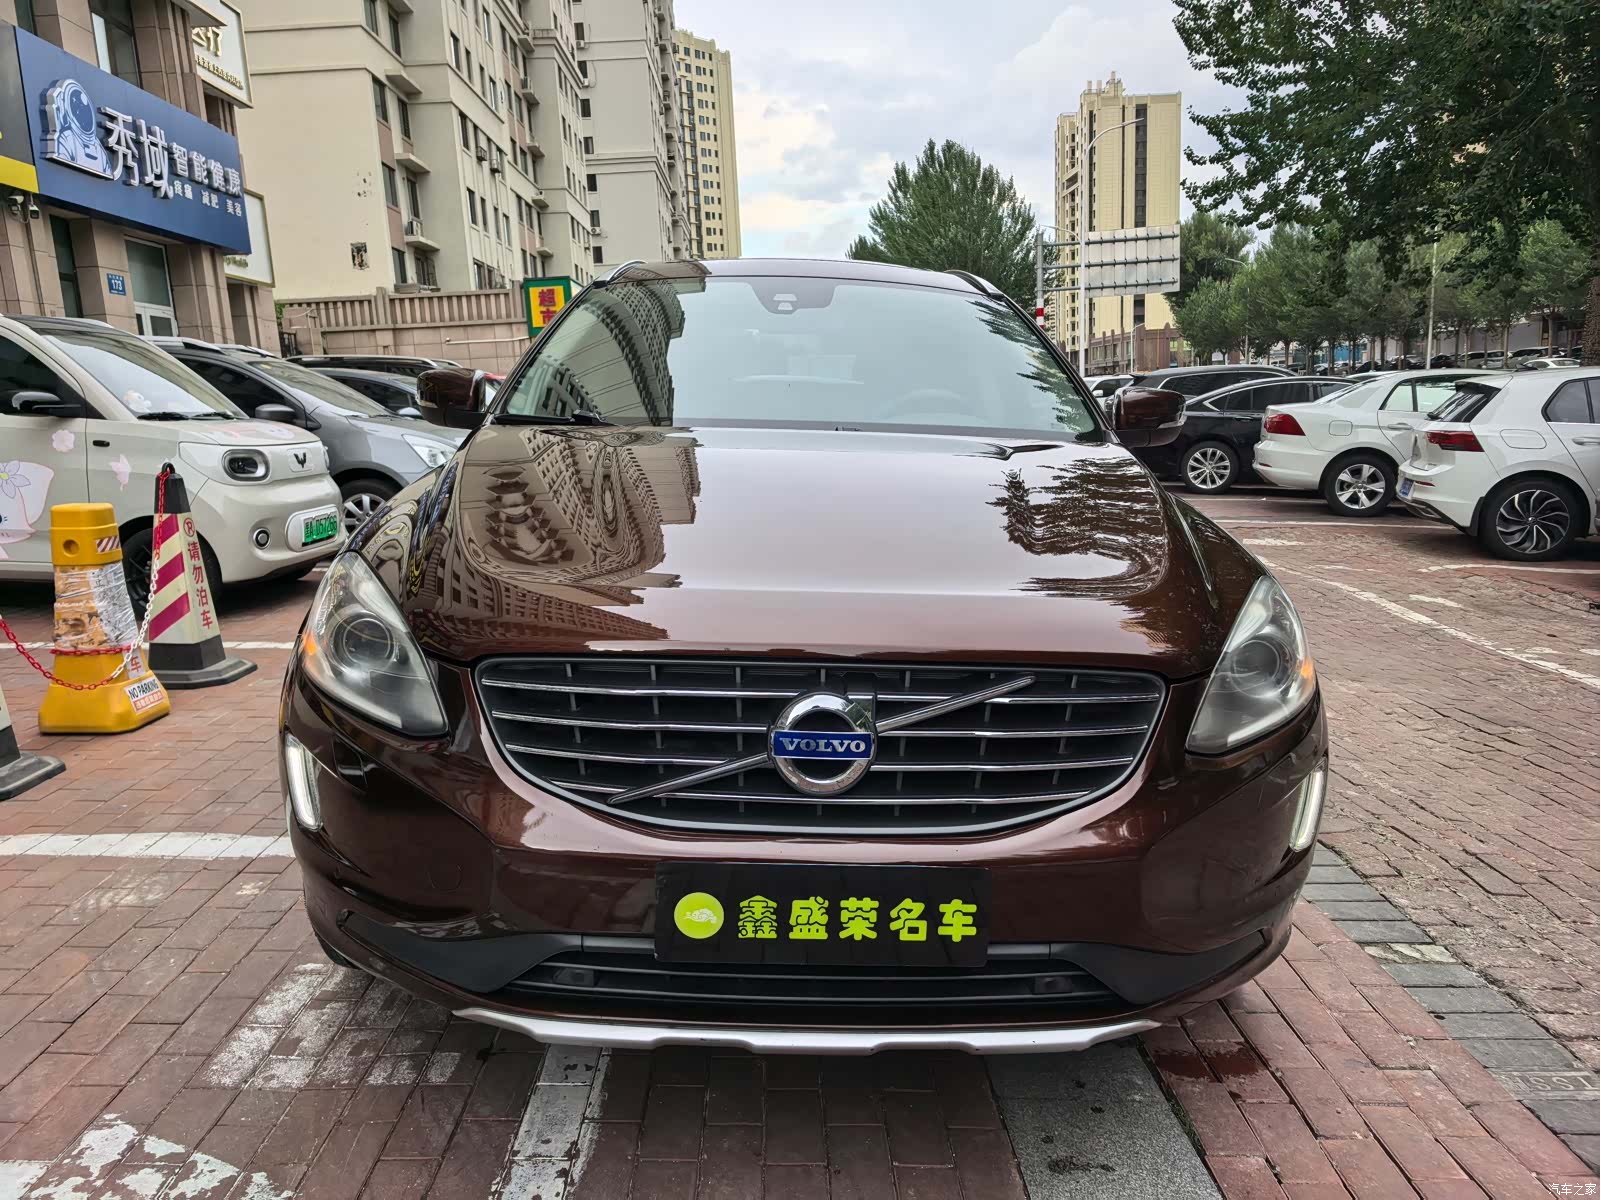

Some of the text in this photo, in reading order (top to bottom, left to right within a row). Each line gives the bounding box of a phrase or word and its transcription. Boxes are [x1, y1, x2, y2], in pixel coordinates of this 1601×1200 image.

[100, 106, 242, 199] 秀域 智能健康
[226, 198, 242, 217] 美容
[187, 541, 213, 629] 请勿泊车
[128, 678, 159, 700] NO PARKING
[779, 737, 866, 753] VOLVO
[737, 895, 977, 942] 鑫盛荣名车
